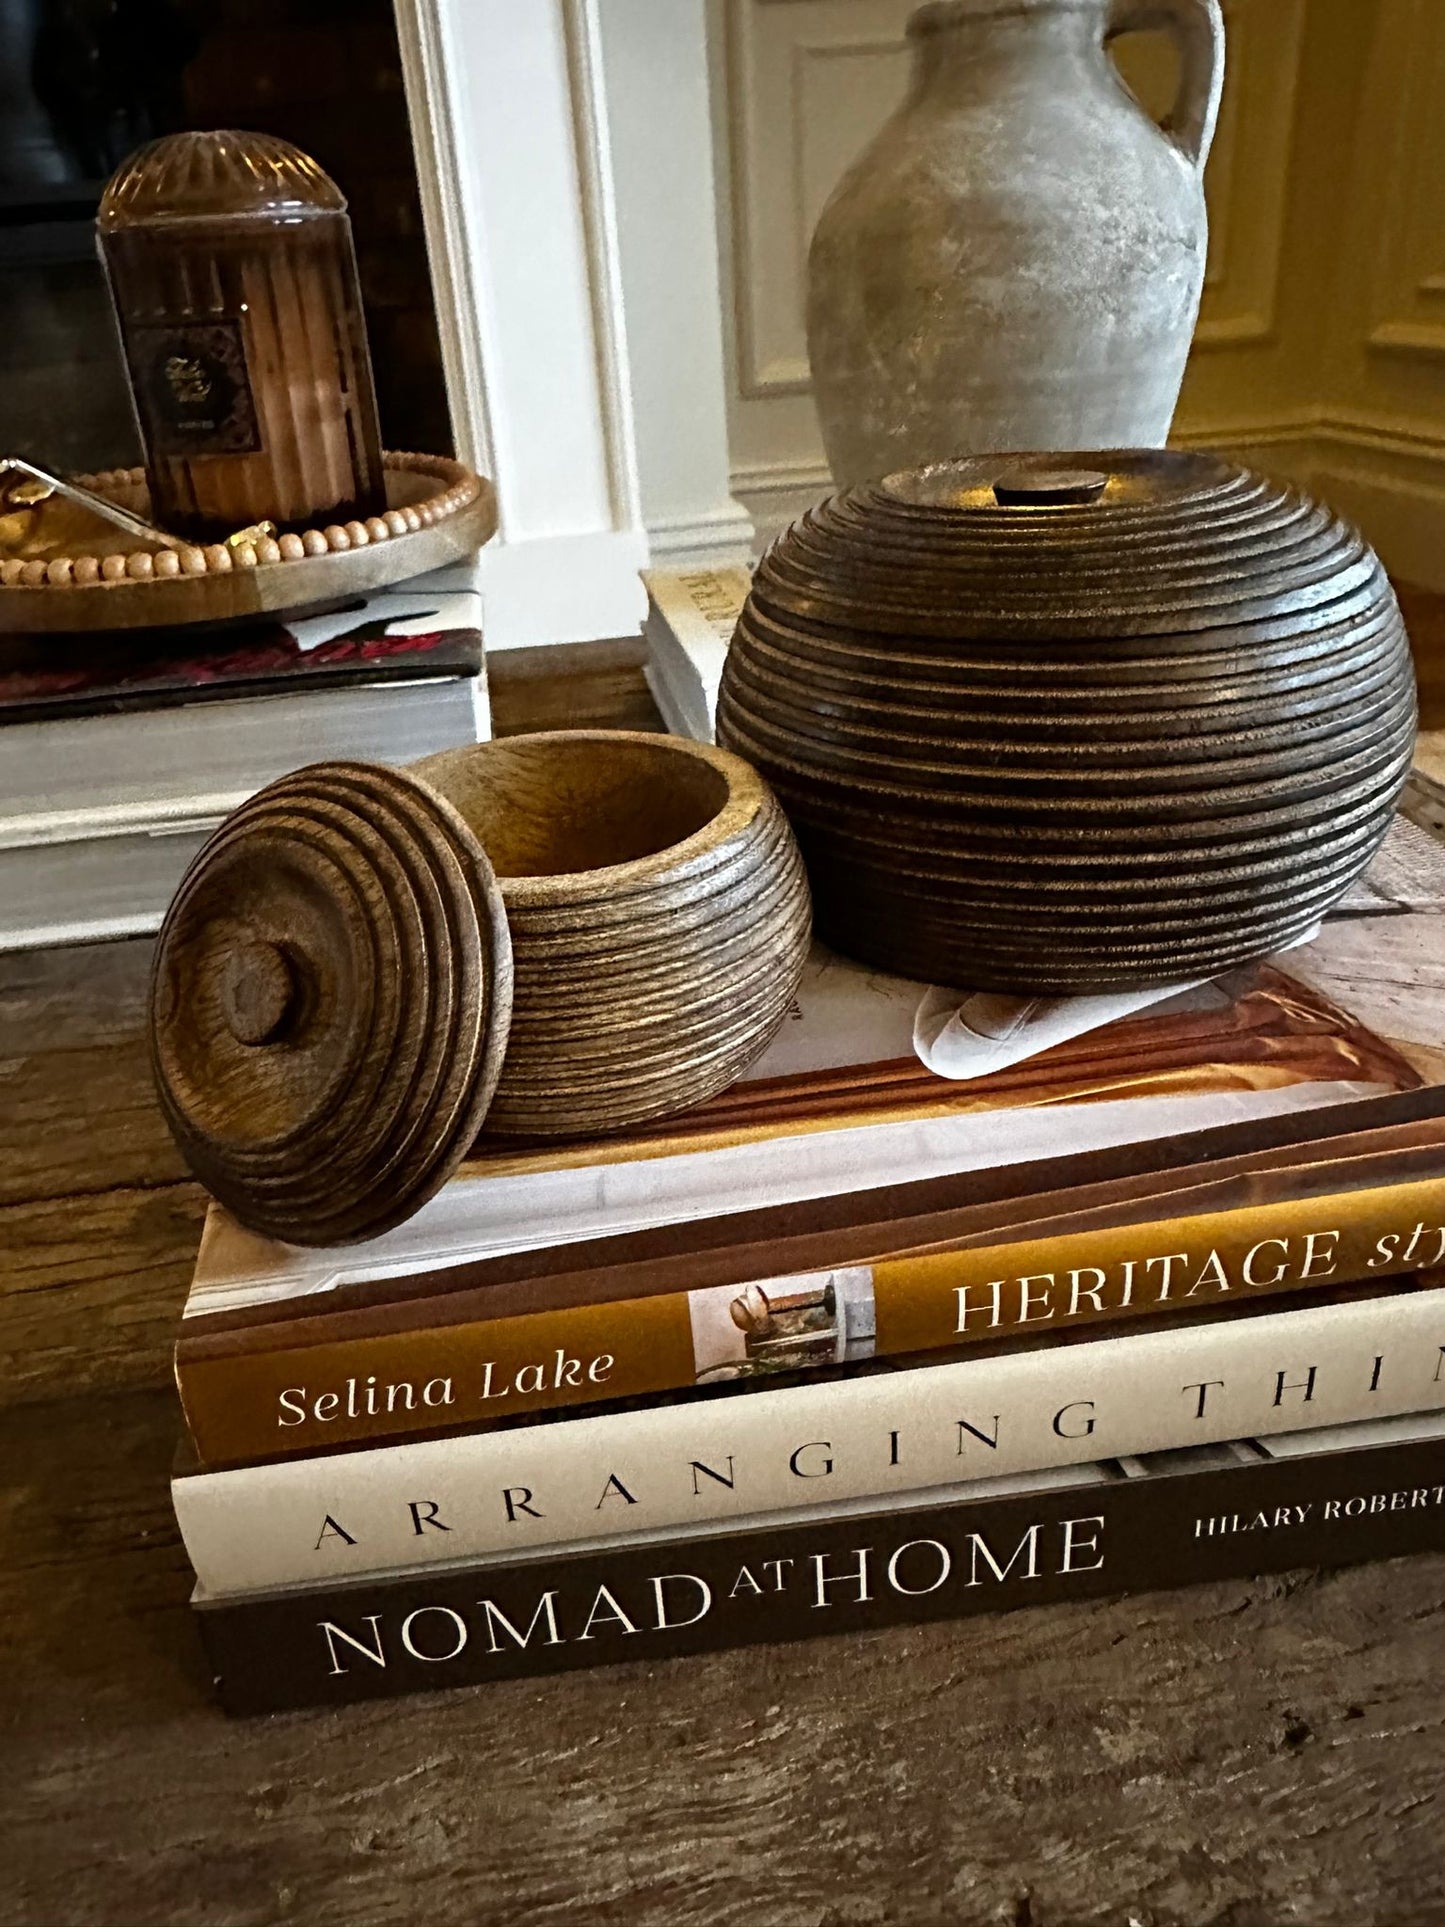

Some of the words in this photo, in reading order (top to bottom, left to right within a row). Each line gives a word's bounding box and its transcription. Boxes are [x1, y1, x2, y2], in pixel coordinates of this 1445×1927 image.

[952, 1230, 1339, 1333] HERITAGE
[278, 1377, 455, 1426] Selina
[480, 1350, 614, 1399] Lake
[315, 1401, 1097, 1550] ARRANGING
[1182, 1347, 1445, 1418] THI
[1195, 1504, 1312, 1537] HILARY
[317, 1574, 712, 1675] NOMAD
[728, 1558, 794, 1598] AT
[809, 1515, 1105, 1608] HOME
